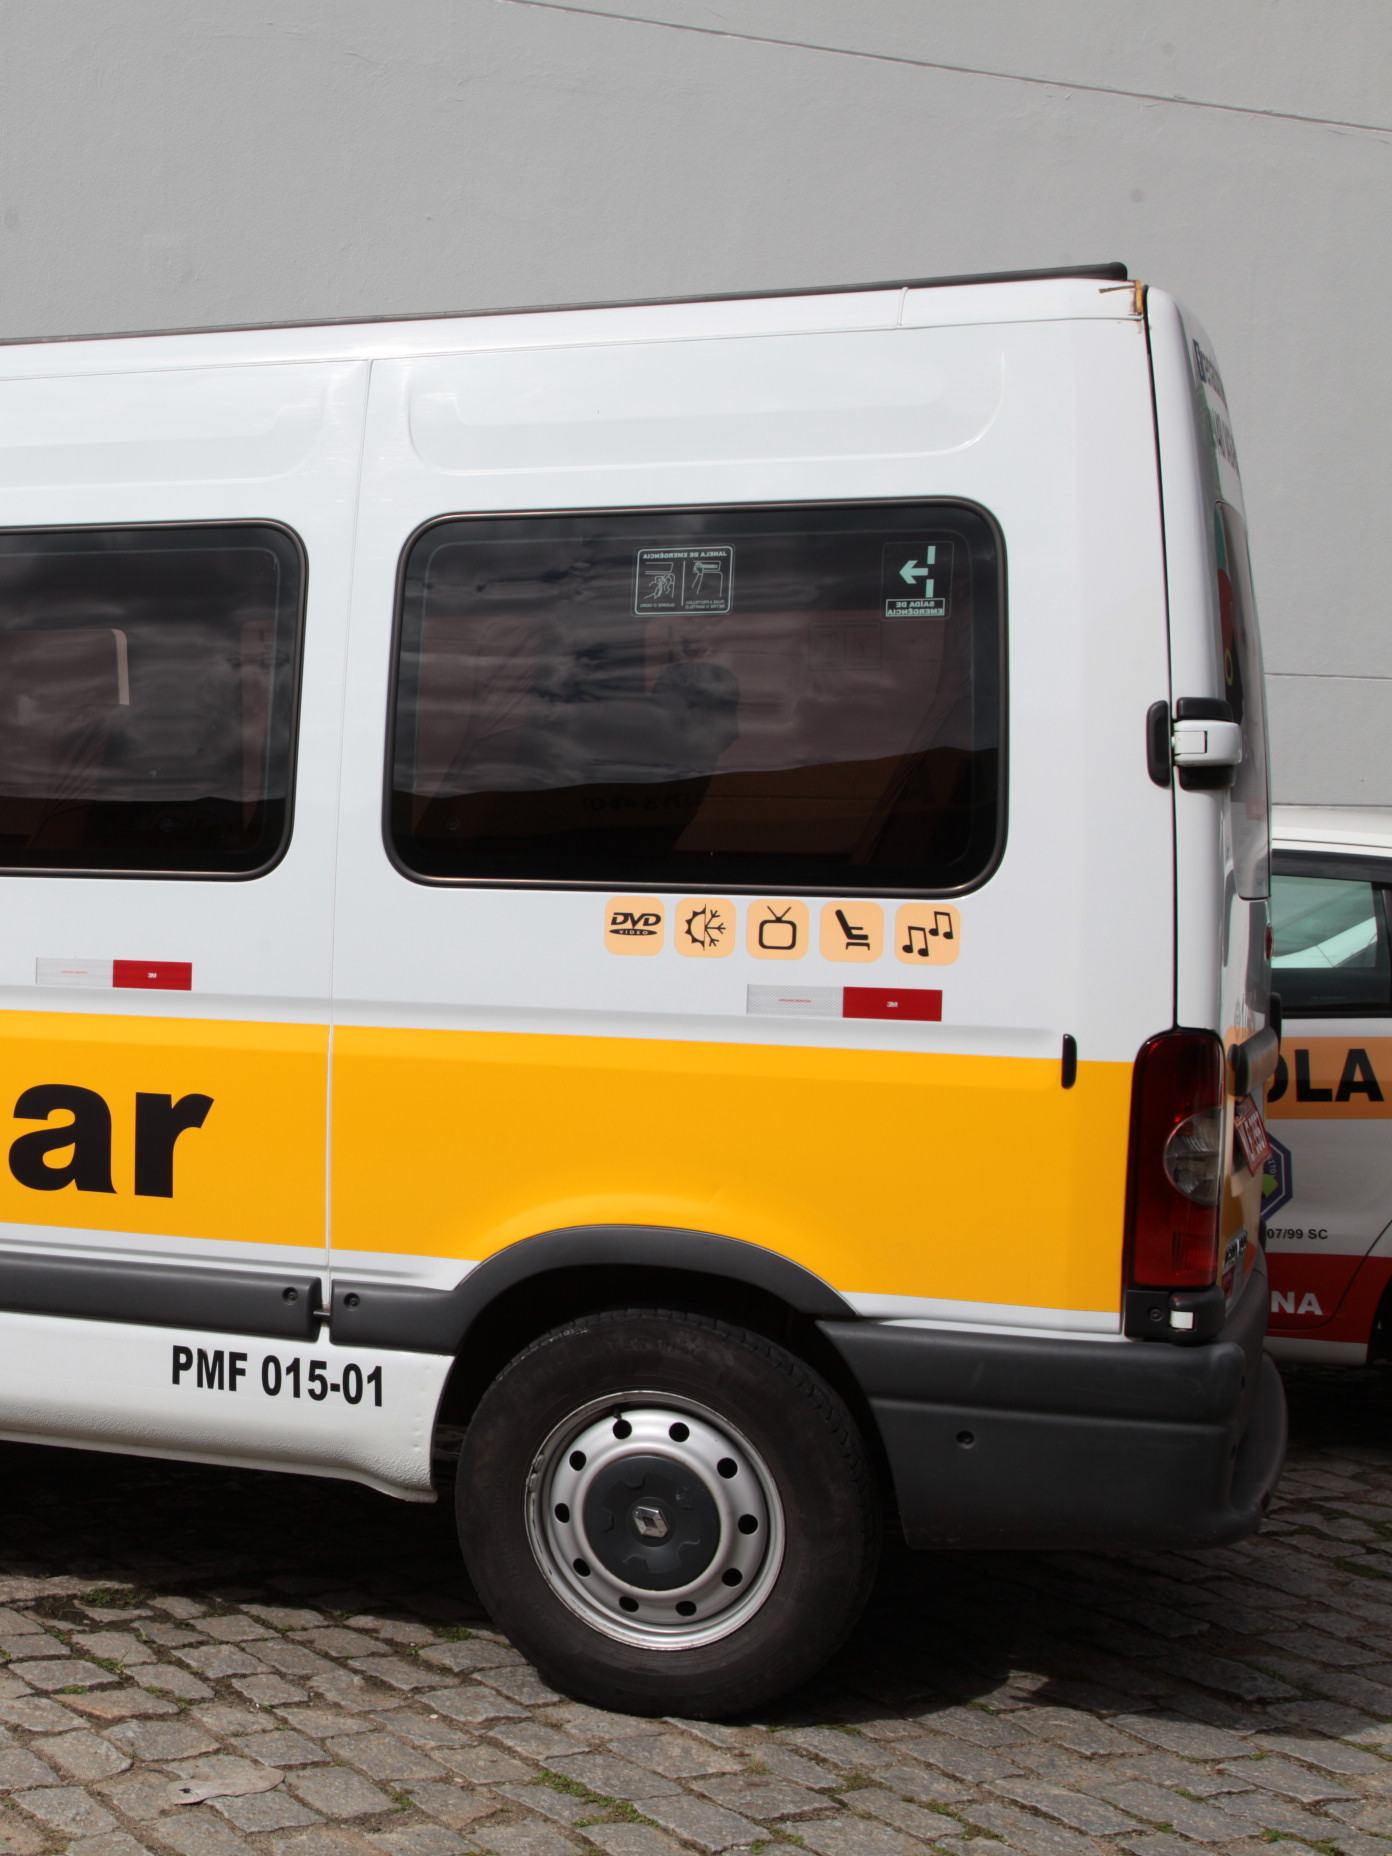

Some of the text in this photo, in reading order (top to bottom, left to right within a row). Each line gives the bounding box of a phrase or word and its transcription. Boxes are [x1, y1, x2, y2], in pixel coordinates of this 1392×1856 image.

[610, 911, 662, 929] DVD
[1267, 1228, 1328, 1240] 07/99 SC
[1271, 1290, 1323, 1315] NA
[172, 1344, 383, 1407] PMF 015-01
